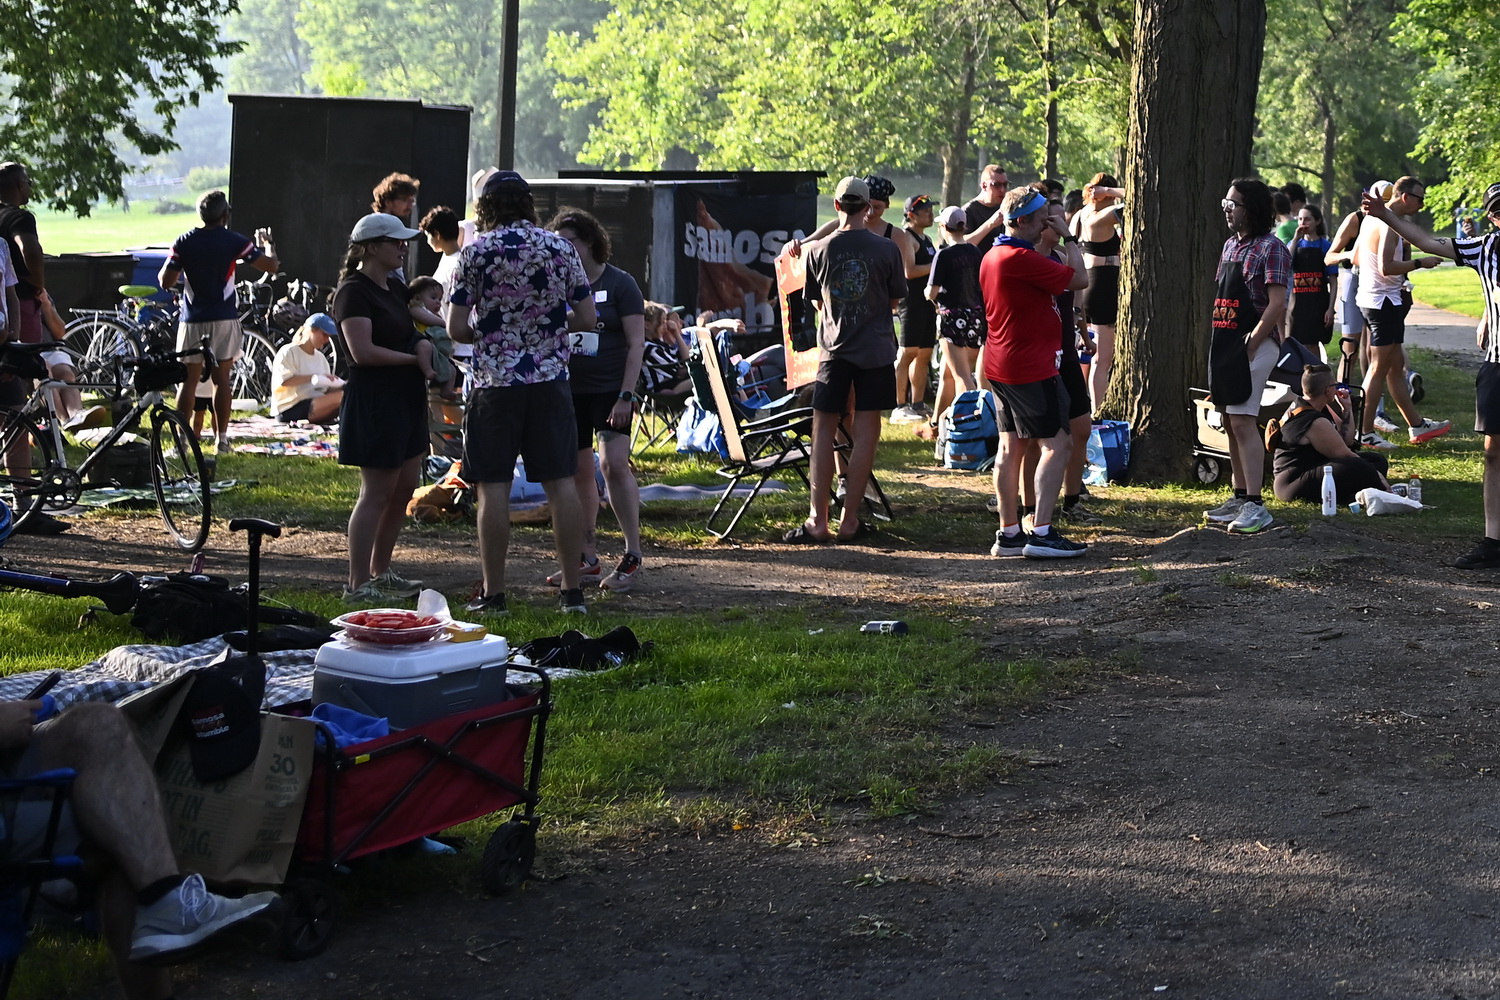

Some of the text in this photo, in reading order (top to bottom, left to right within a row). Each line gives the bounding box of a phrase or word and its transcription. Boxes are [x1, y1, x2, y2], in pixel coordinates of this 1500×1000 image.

[573, 333, 583, 348] 2
[191, 712, 225, 725] samosa
[195, 725, 230, 738] stumble
[270, 753, 296, 776] 30
